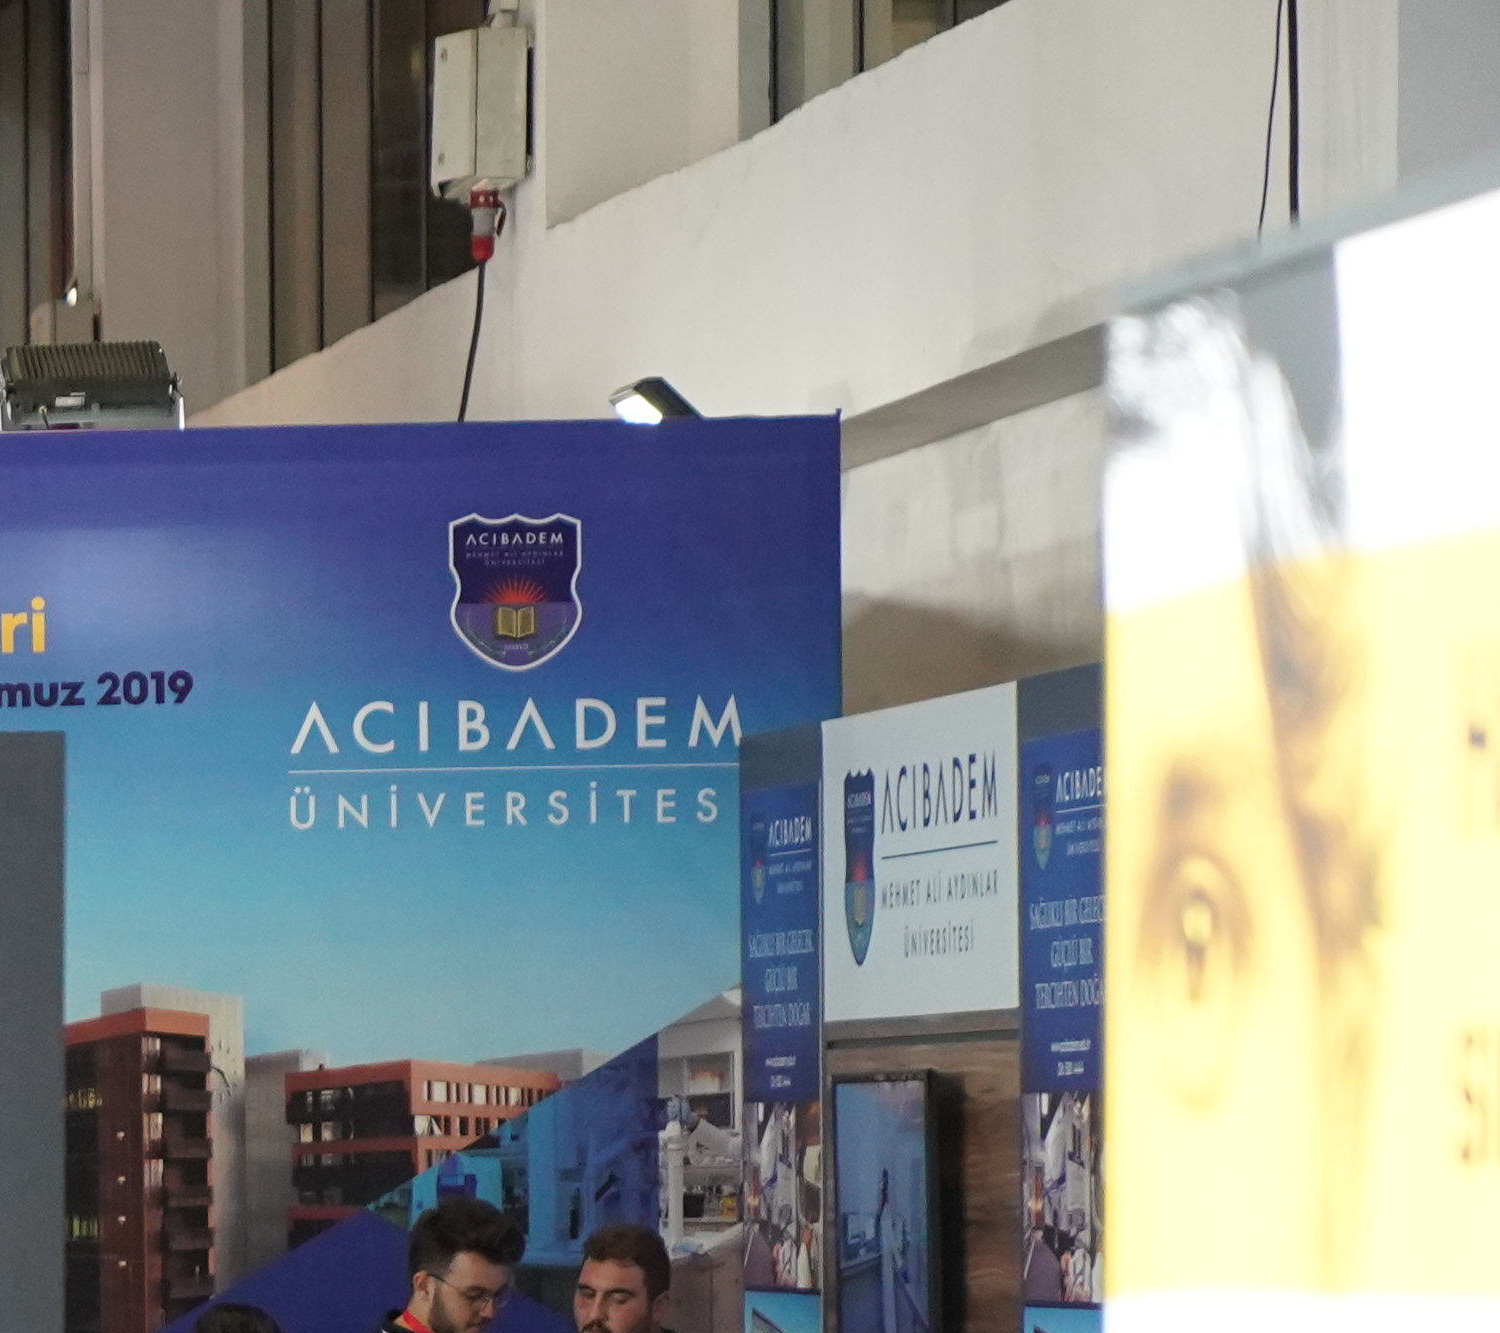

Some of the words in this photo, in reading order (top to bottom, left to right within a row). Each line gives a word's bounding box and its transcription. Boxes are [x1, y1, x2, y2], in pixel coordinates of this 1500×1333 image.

[466, 532, 563, 546] ACIBADEM
[97, 671, 194, 706] 2019
[290, 694, 742, 755] ACIBADEM
[881, 749, 998, 834] ACIBADEM
[1056, 766, 1104, 803] ACIBADE
[290, 782, 720, 830] ÜNİVERSİTES
[881, 878, 920, 909] MEHMET
[926, 871, 942, 901] ALİ
[946, 870, 998, 900] AYDINLAR
[904, 919, 974, 958] ÜNİVERSİTESİ
